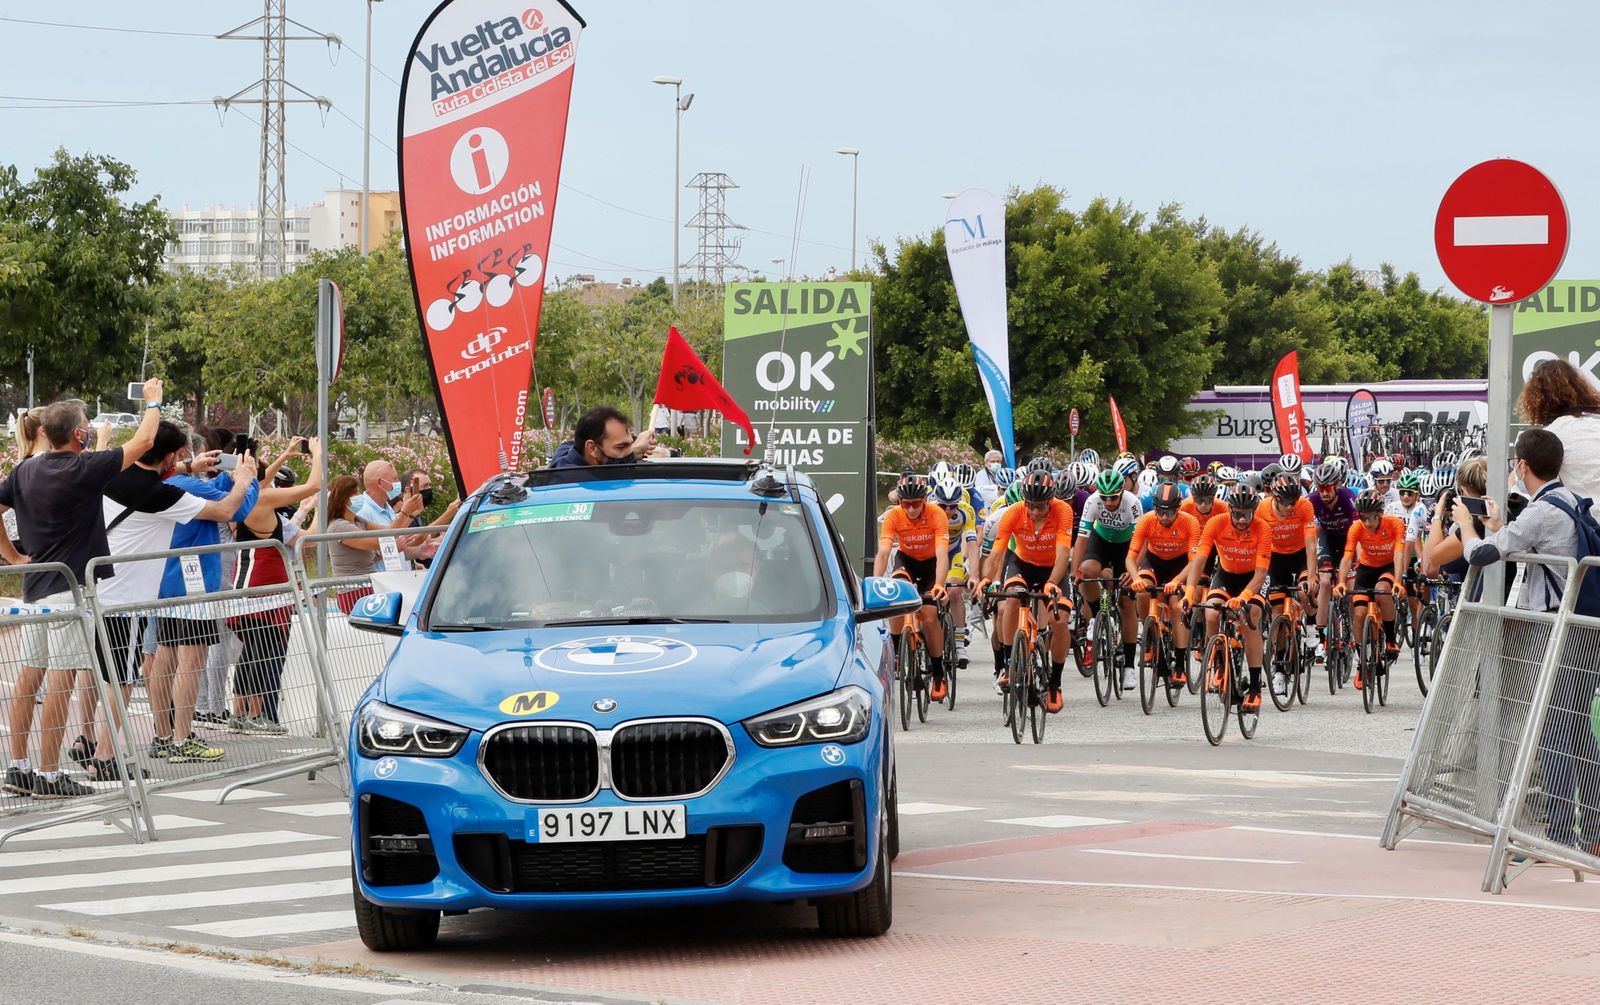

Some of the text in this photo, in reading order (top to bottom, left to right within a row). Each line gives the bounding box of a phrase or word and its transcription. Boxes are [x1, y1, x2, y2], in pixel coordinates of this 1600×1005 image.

[416, 16, 523, 73] Vuelta
[430, 26, 571, 101] Andalucía
[433, 44, 574, 117] Ruta Ciclista del Sol
[425, 180, 542, 242] INFORMACIÓN
[429, 201, 545, 262] INFORMATION
[733, 288, 861, 315] SALIDA
[1513, 286, 1600, 312] ALID
[443, 340, 531, 384] deporinter
[755, 351, 835, 392] OK
[754, 397, 820, 414] mobility
[508, 389, 528, 473] lucia.com
[828, 429, 852, 444] DE
[1288, 410, 1303, 454] SUR
[514, 513, 590, 525] DIRECTOR TÉCNICO
[572, 503, 587, 514] 30
[512, 692, 547, 713] M
[529, 829, 535, 837] E
[543, 809, 676, 837] 9197 LNX
